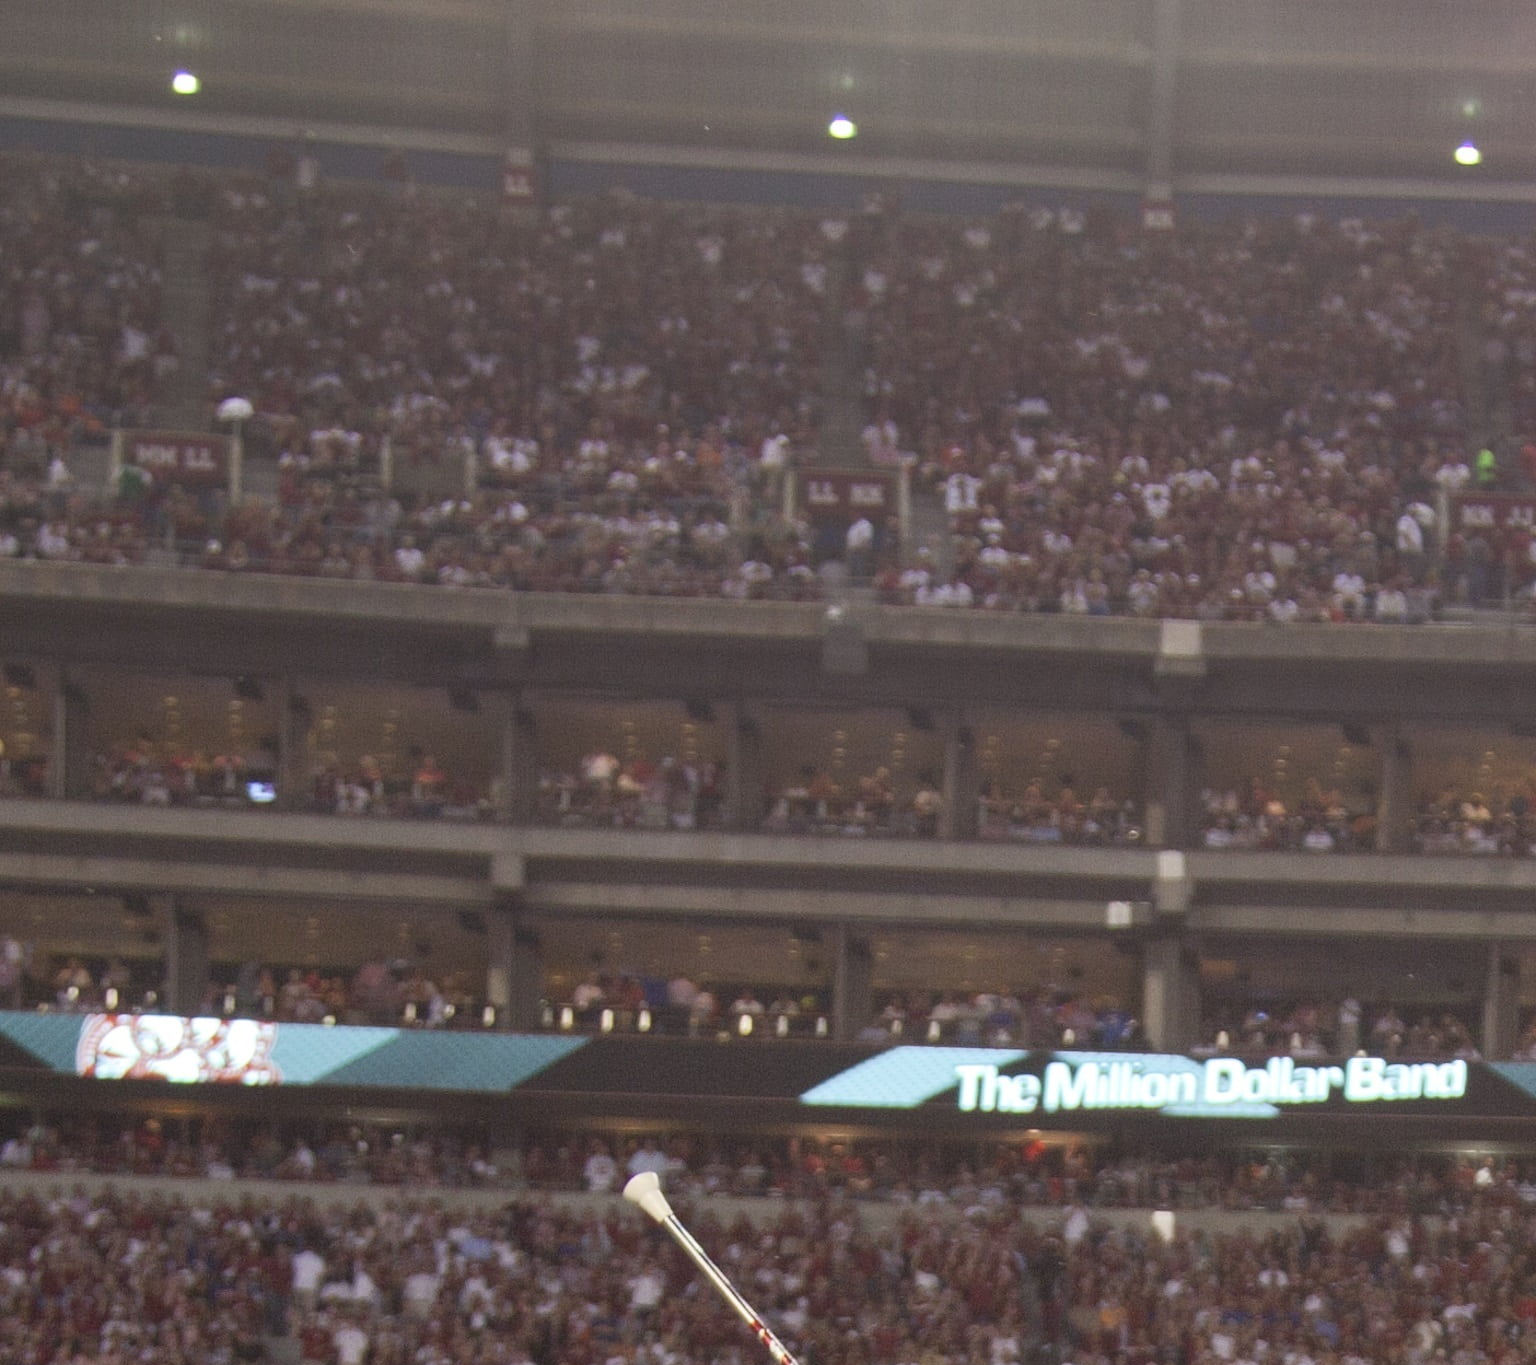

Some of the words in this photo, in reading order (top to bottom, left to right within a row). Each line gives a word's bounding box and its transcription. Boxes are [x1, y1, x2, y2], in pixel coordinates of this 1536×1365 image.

[184, 444, 217, 471] LL
[808, 480, 840, 504] LL
[1506, 504, 1534, 527] JJ
[956, 1064, 1041, 1113] The
[1043, 1061, 1203, 1114] Million
[1204, 1056, 1344, 1105] Dollar
[1344, 1057, 1468, 1101] Band
